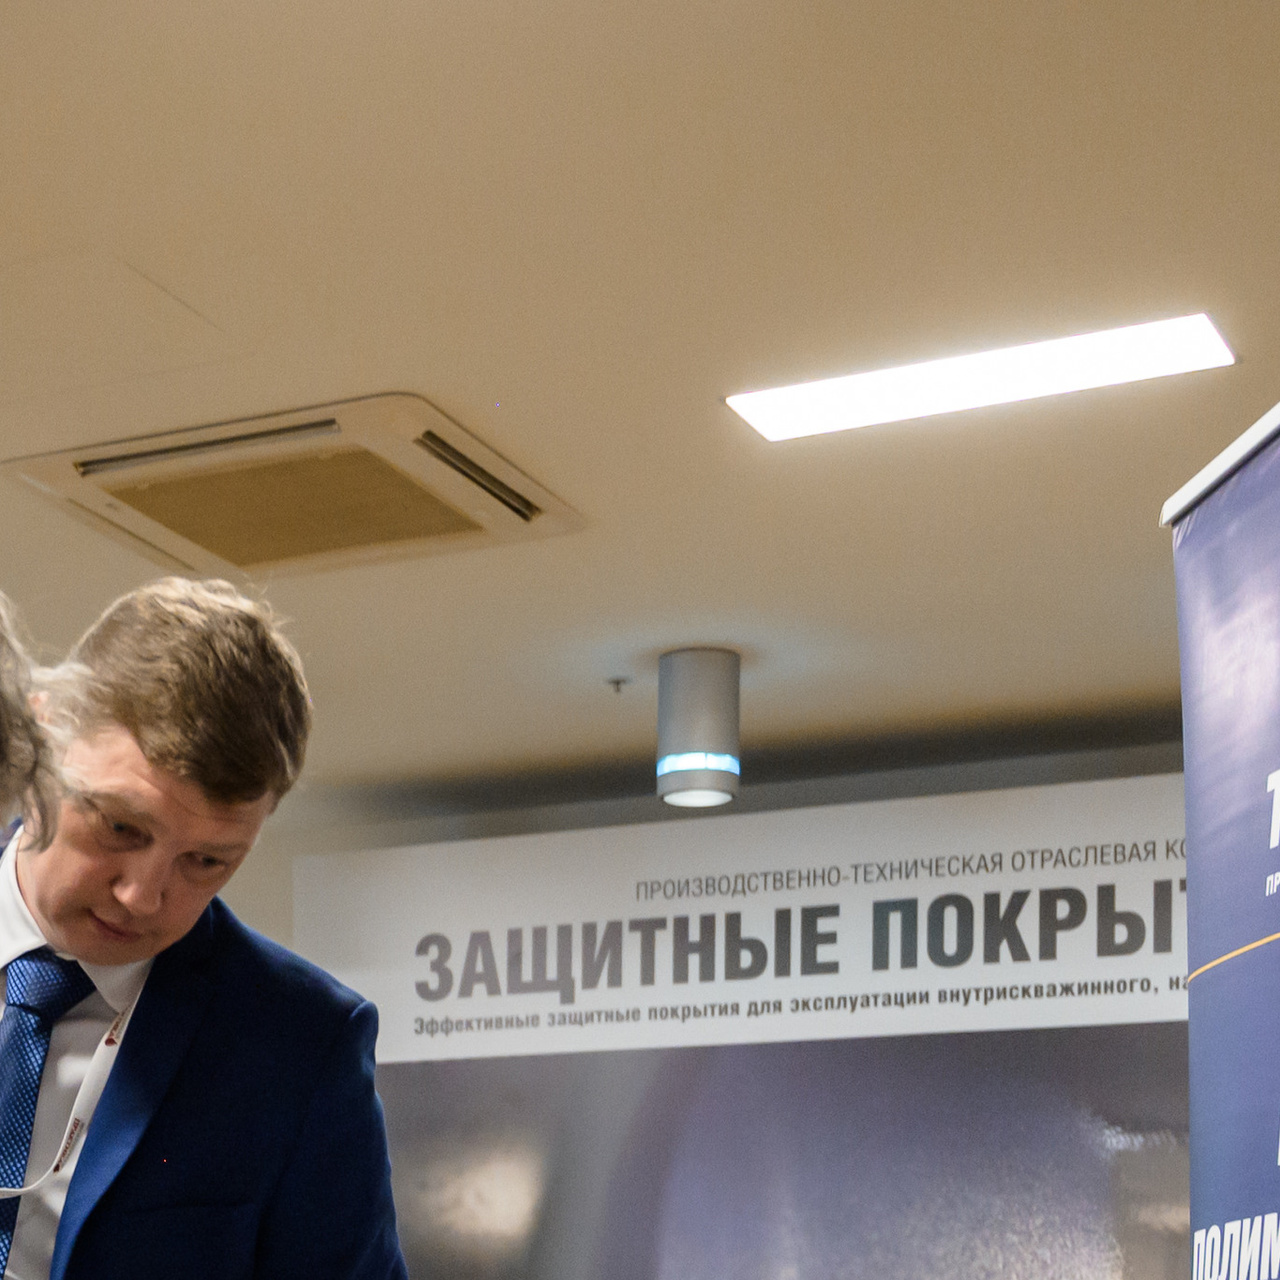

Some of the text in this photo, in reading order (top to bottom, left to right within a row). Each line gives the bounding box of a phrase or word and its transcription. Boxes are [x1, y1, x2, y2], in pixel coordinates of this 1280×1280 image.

[636, 852, 1003, 901] ПРОИЗВОДСТВЕННО-ТЕХНИЧЕСКАЯ
[1011, 840, 1157, 873] ОТРАСЛЕВАЯ
[415, 877, 1187, 1005] ЗАЩИТНЫЕ ПОКРЫ
[414, 1012, 541, 1037] Эффективные
[547, 1005, 641, 1028] защитные
[648, 1001, 740, 1025] покрытия
[747, 1000, 783, 1018] для
[790, 989, 935, 1014] эксплуатации
[937, 976, 1158, 1006] внутрискважинного,
